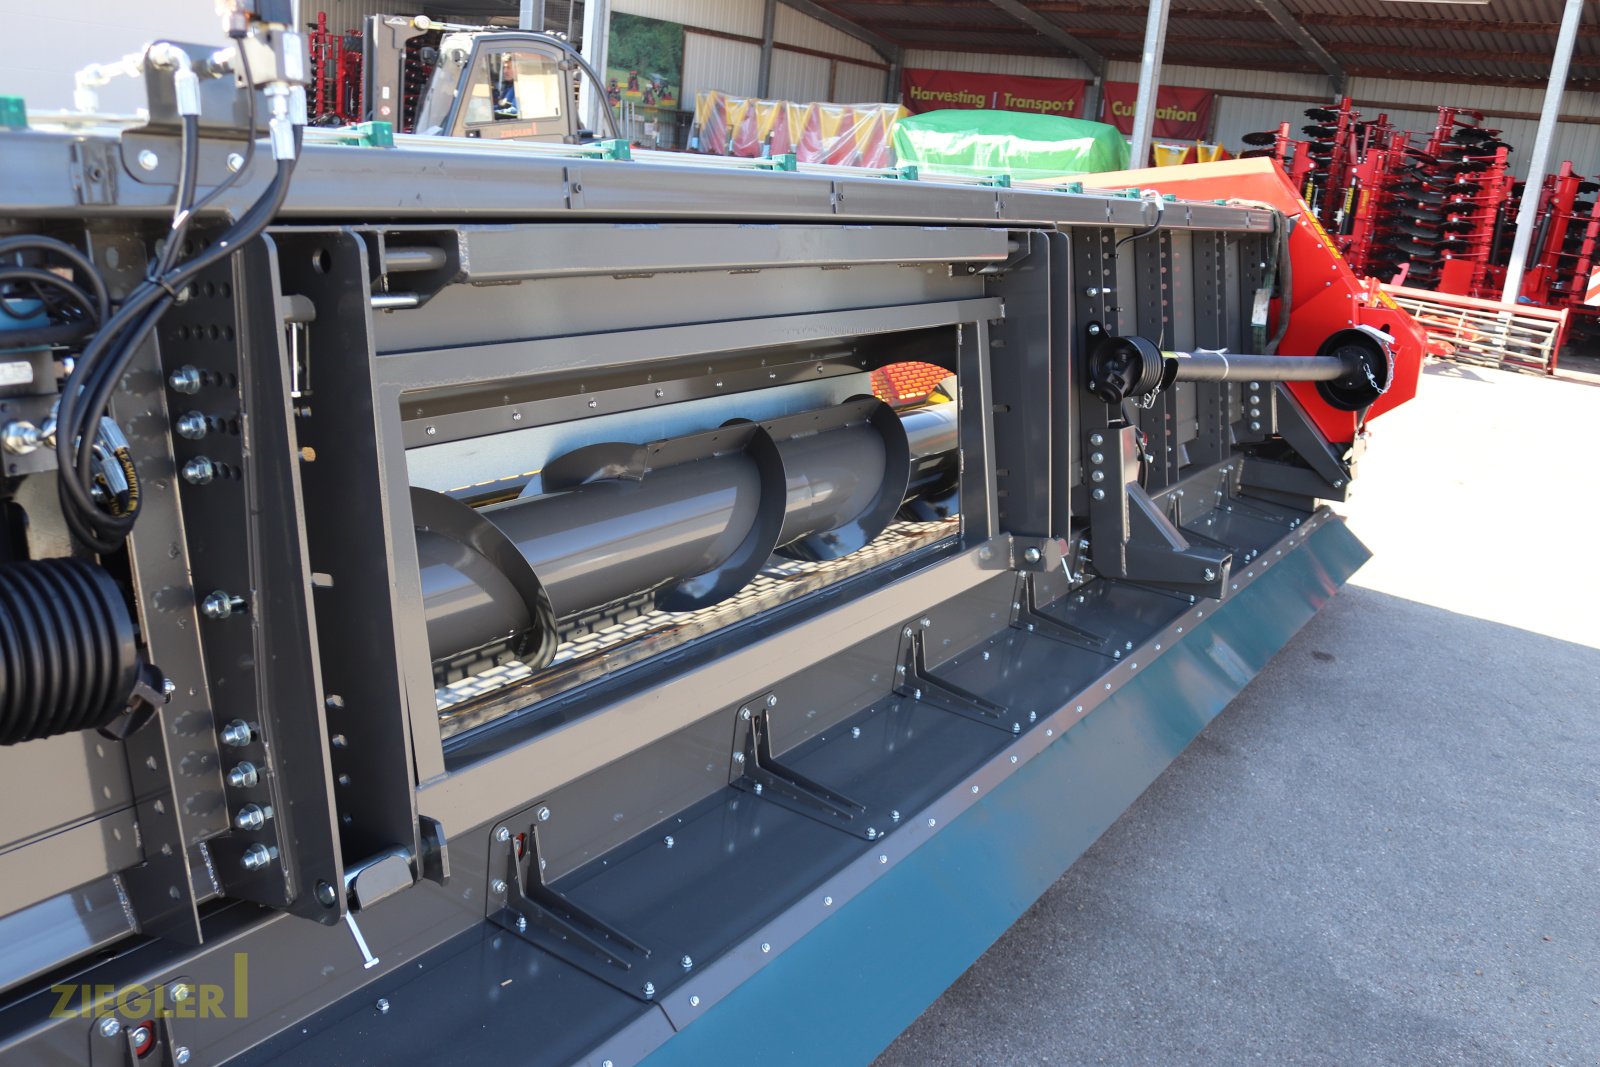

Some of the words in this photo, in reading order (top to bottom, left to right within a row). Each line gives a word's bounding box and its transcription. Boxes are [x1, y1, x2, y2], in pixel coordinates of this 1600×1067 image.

[910, 86, 986, 109] Harvesting
[1003, 93, 1075, 113] Transport
[1112, 101, 1197, 121] Culation
